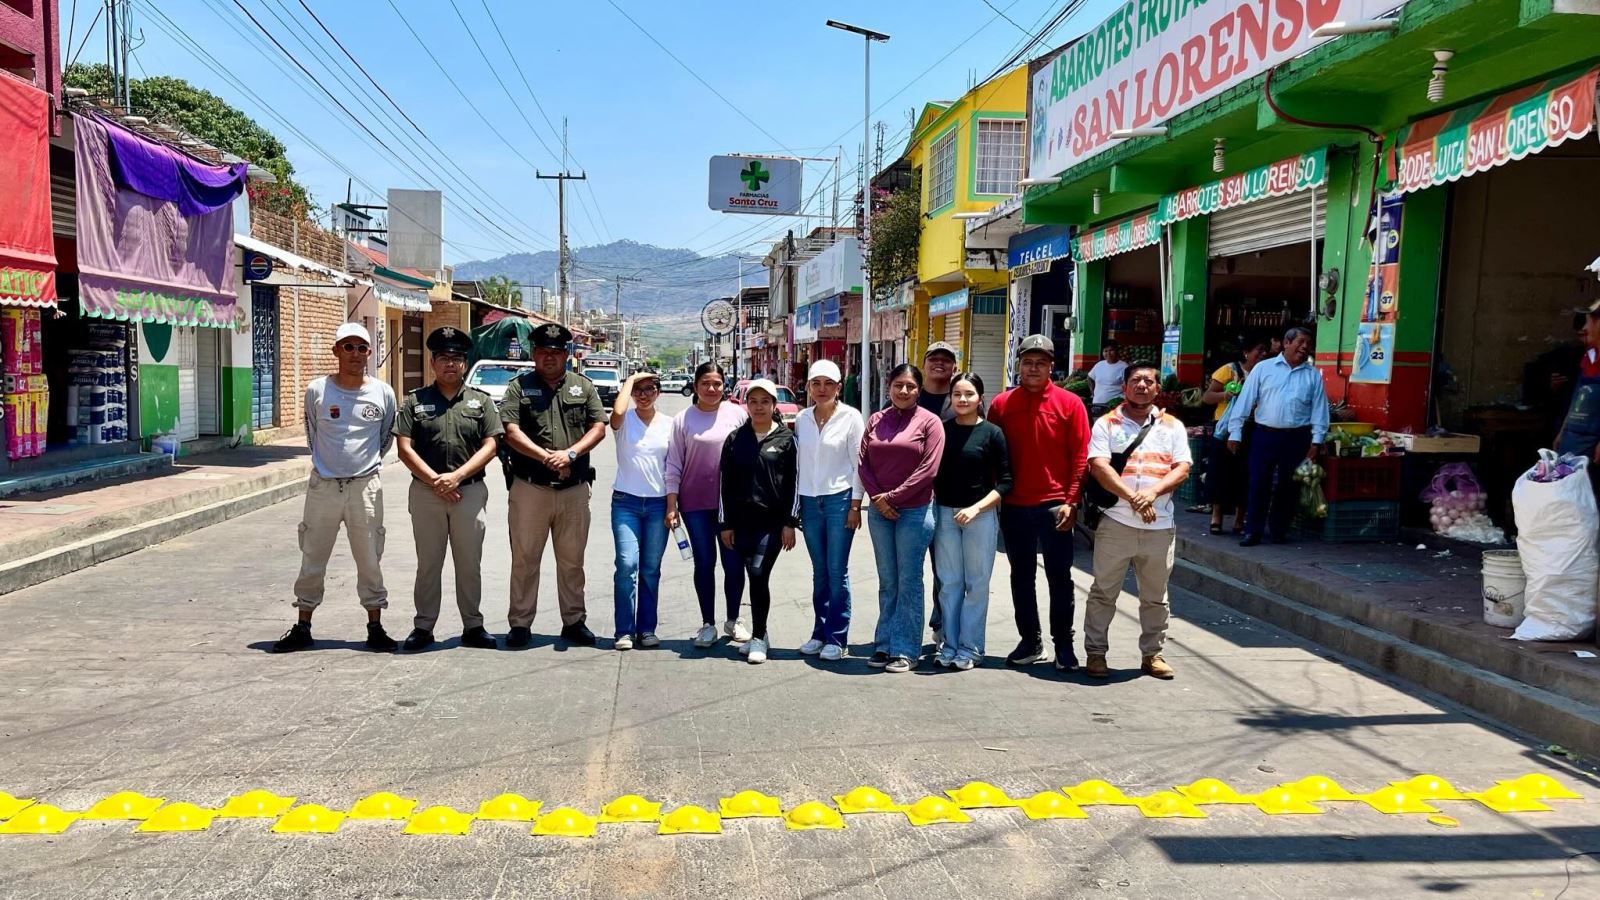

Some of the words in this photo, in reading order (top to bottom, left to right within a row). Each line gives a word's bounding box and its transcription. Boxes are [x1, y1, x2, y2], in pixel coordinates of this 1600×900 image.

[1050, 2, 1134, 106] ABARROTES
[1136, 0, 1208, 49] FRU
[1072, 79, 1128, 157] SAN
[1467, 126, 1496, 166] SAN
[1498, 95, 1574, 155] LORENSO
[729, 197, 756, 205] Santa
[757, 198, 778, 207] Cruz
[1166, 181, 1225, 217] ABARROTES
[1227, 173, 1250, 201] SAN
[1252, 156, 1316, 195] LORENSO
[1020, 244, 1053, 265] TELCEL
[1119, 229, 1131, 250] SAN
[129, 319, 138, 382] TES
